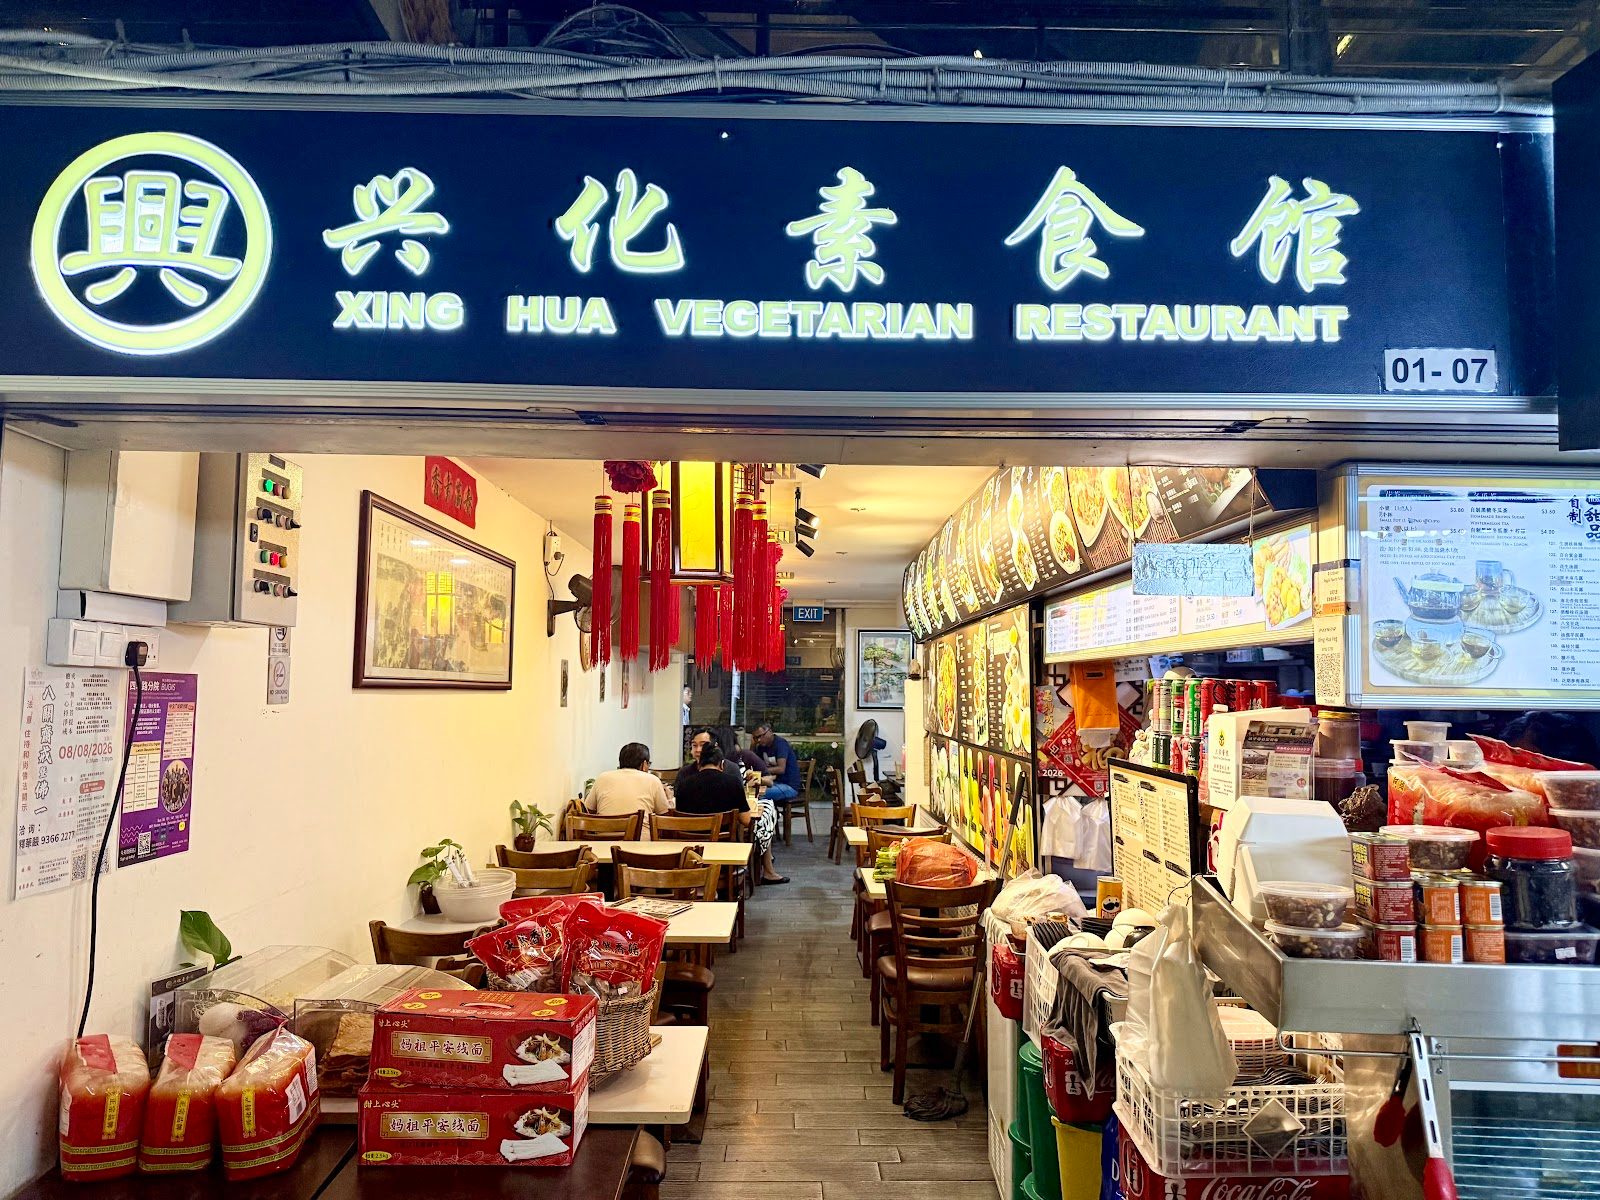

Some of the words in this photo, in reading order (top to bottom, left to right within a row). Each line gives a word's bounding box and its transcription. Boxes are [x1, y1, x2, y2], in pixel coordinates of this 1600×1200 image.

[60, 169, 243, 307] 興
[321, 165, 1361, 294] 兴化素食馆
[333, 290, 466, 332] XING
[506, 294, 618, 335] HUA
[655, 297, 975, 341] VEGETARIAN
[1014, 303, 1351, 343] RESTAURANT
[1450, 356, 1490, 386] 07
[798, 607, 819, 619] EXIT
[129, 680, 160, 692] 四路分院
[160, 683, 176, 691] BUGIS
[58, 742, 113, 760] 08/08/2026
[1042, 769, 1064, 777] 2026
[40, 833, 60, 846] 9366
[60, 830, 76, 842] 2277
[399, 1037, 484, 1057] 妈祖平安线面
[389, 1117, 481, 1133] 妈祖平安线面
